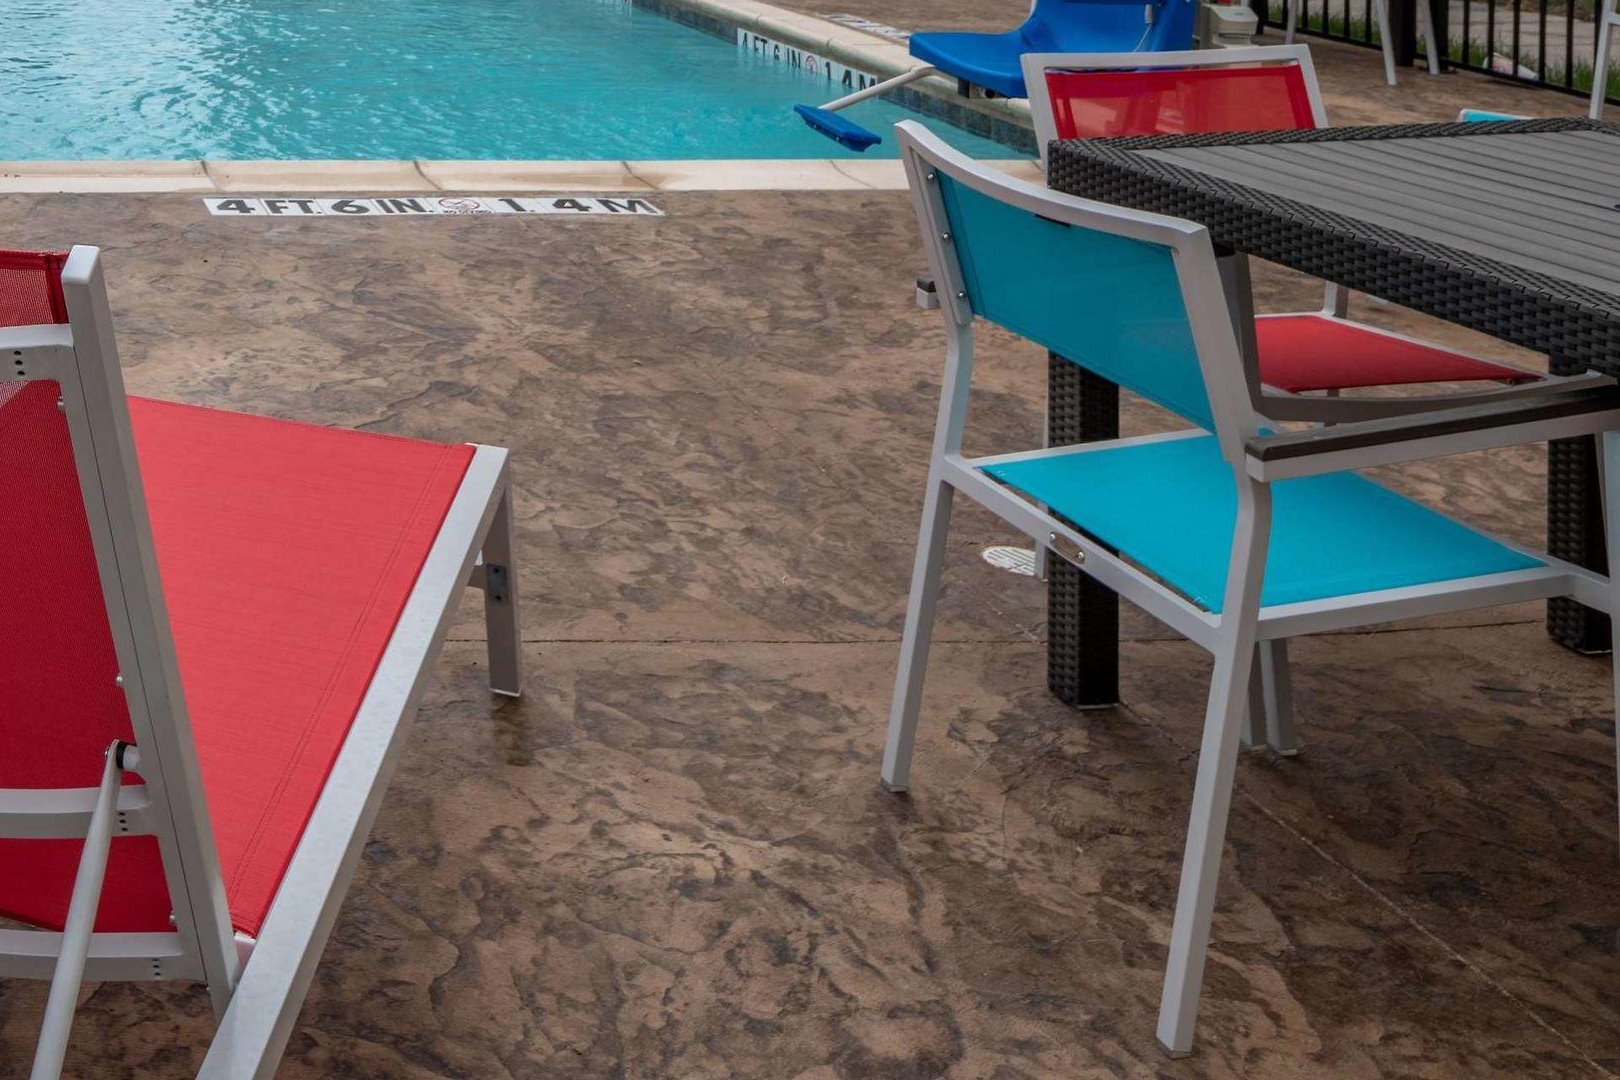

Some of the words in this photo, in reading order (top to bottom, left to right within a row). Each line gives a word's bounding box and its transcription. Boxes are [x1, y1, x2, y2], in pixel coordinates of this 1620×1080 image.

[754, 35, 768, 54] FT
[786, 48, 801, 69] IN
[216, 199, 255, 214] 4
[330, 200, 370, 214] 6
[596, 199, 658, 214] M
